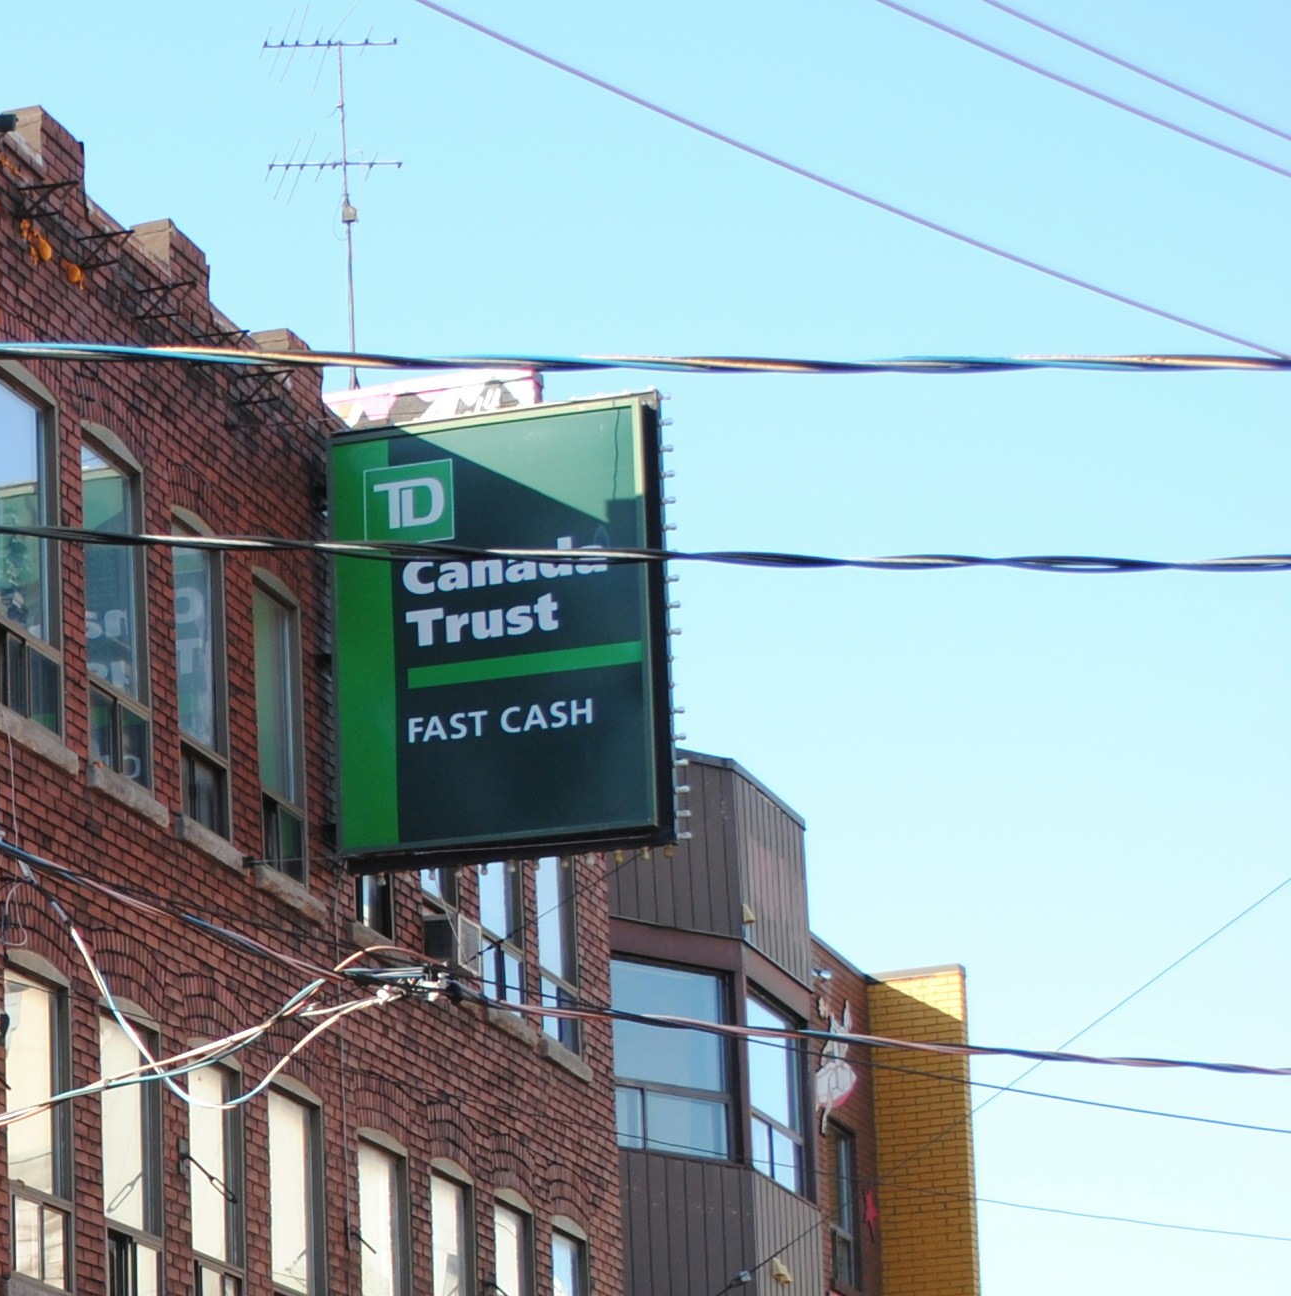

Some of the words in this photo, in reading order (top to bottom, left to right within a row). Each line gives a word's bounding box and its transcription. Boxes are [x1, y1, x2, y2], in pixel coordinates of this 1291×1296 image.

[373, 477, 445, 529] TD
[402, 537, 609, 596] Canada
[405, 592, 560, 647] Trust
[407, 710, 488, 743] FAST
[500, 698, 593, 734] CASH
